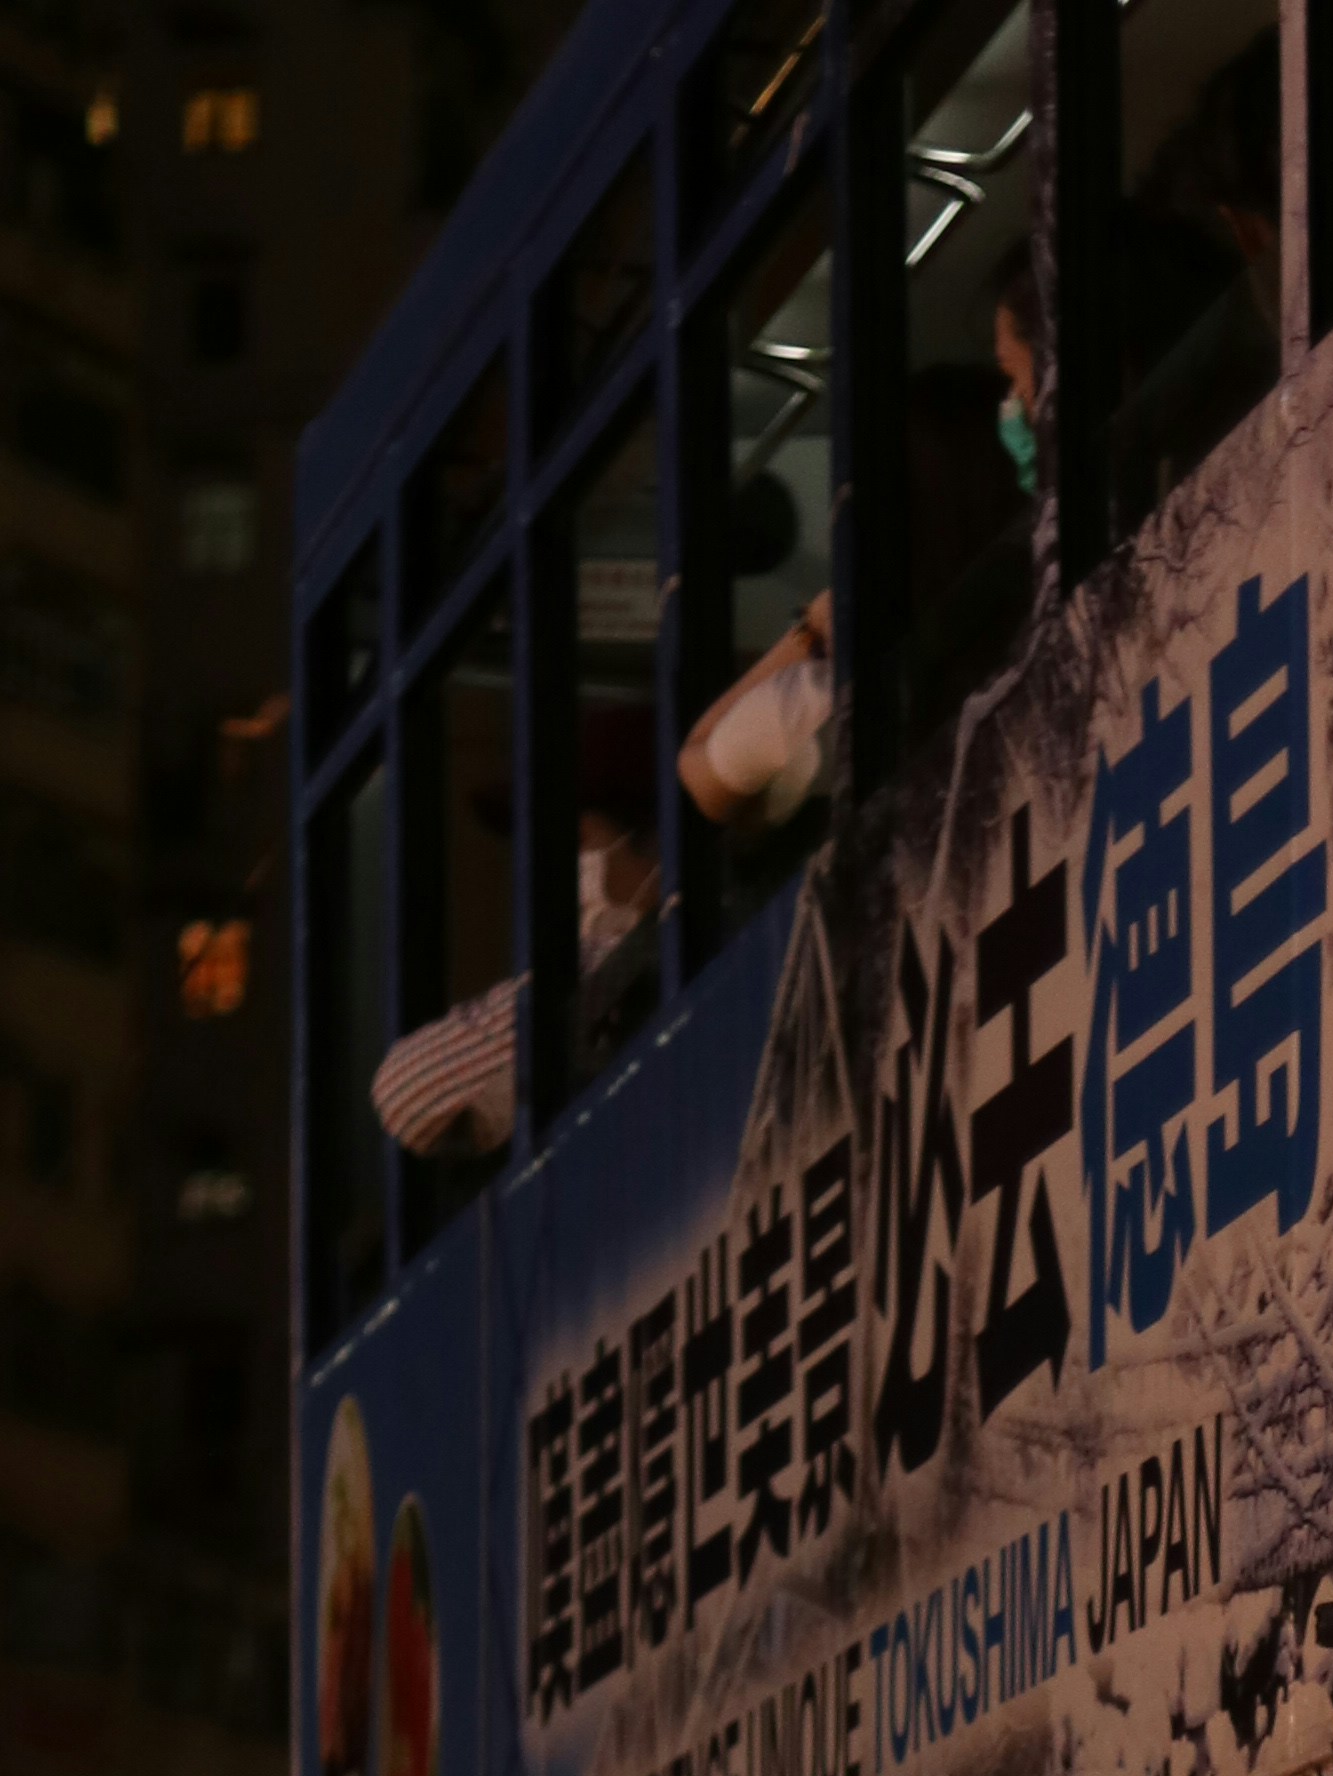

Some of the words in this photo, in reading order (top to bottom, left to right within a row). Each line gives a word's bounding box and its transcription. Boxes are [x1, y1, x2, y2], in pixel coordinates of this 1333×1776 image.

[873, 571, 1329, 1476] 必去德島
[870, 1509, 1077, 1776] TOKUSHIMA
[1086, 1412, 1223, 1656] JAPAN
